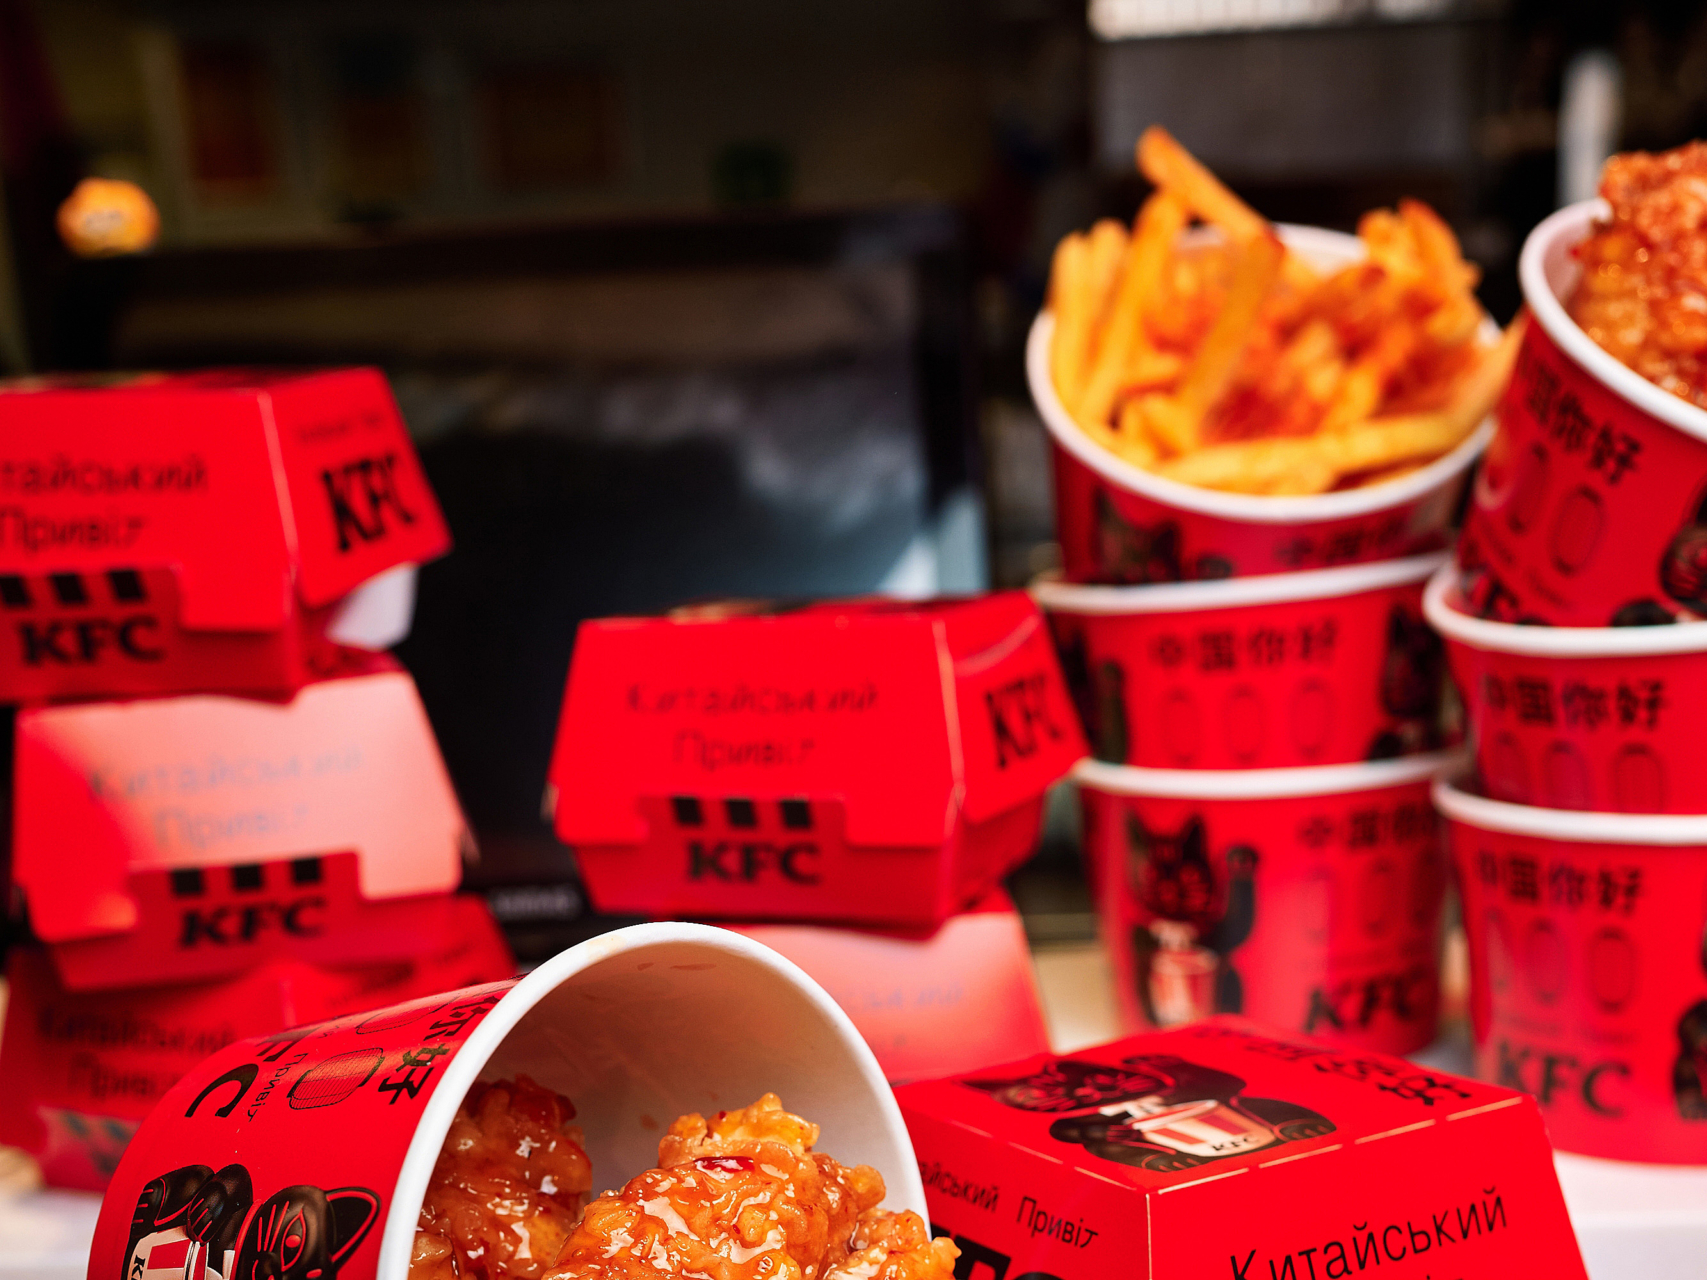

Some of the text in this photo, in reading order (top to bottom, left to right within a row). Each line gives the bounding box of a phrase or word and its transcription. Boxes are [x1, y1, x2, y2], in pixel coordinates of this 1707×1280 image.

[0, 452, 208, 496] тайський
[20, 615, 165, 669] KFC
[688, 841, 821, 884] KFC
[180, 896, 326, 949] KFC
[247, 1052, 309, 1122] Привіт
[1499, 1040, 1632, 1117] KFC
[1212, 1136, 1259, 1153] KFC
[1016, 1196, 1098, 1248] Привіт
